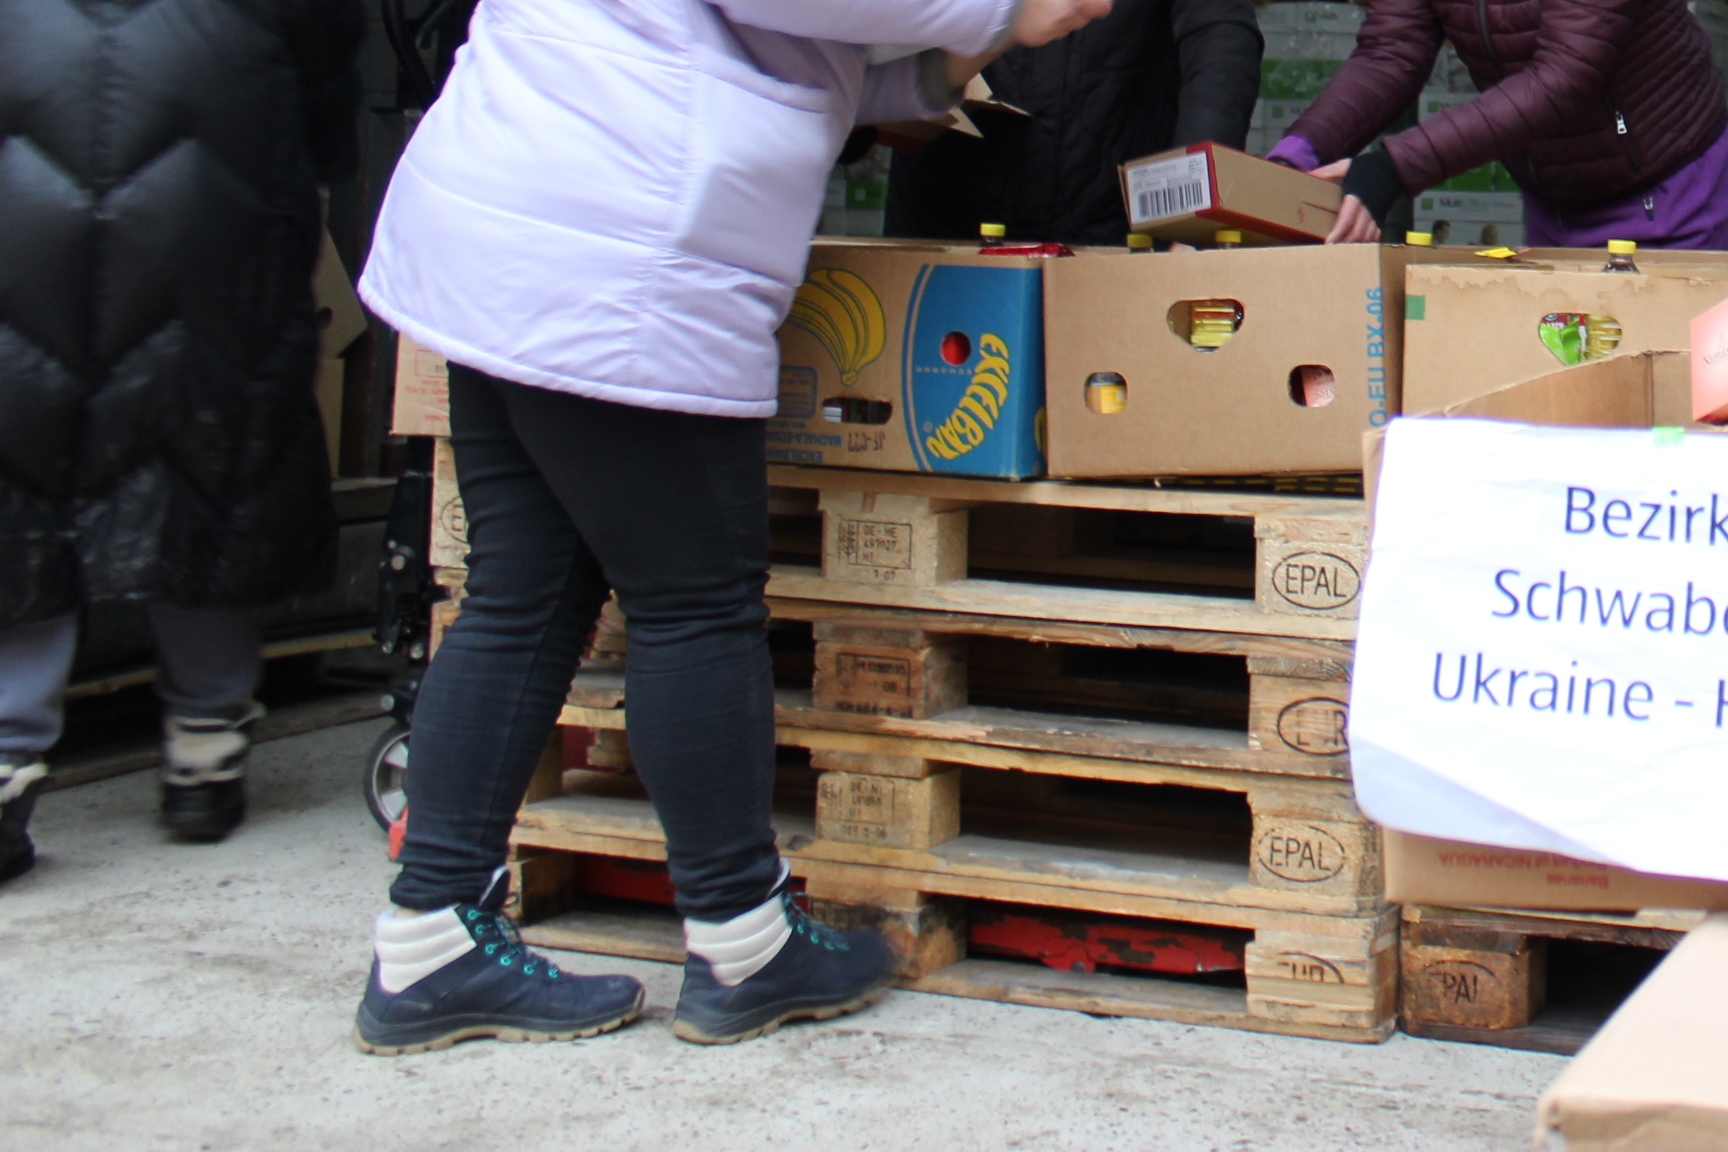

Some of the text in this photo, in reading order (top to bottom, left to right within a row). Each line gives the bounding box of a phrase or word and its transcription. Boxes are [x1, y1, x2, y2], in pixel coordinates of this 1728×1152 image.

[1286, 563, 1347, 598] EPAL
[1431, 652, 1654, 722] Ukraine
[1269, 836, 1332, 871] EPAL
